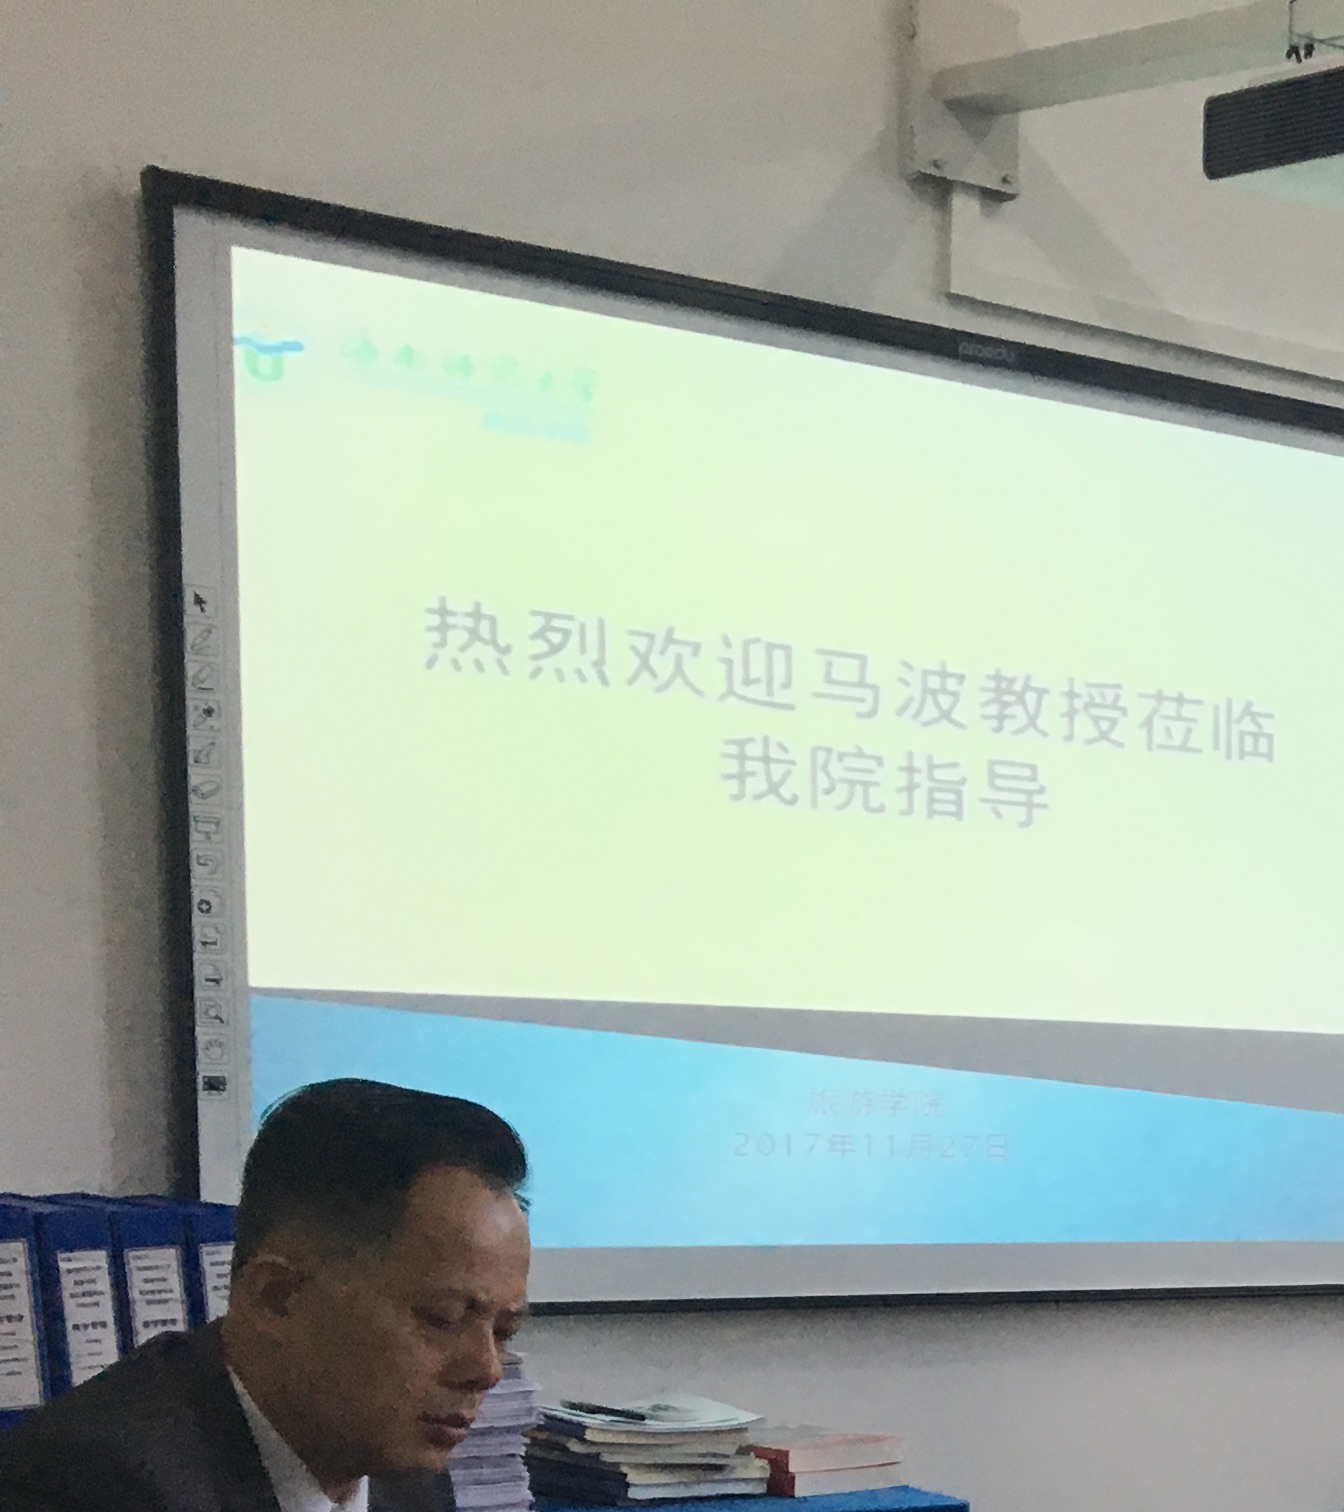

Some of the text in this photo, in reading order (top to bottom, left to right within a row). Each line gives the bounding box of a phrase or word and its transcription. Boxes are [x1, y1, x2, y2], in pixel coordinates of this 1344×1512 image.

[423, 595, 1277, 764] 热烈欢迎马波教授莅临
[720, 734, 1049, 829] 我院指导
[732, 1131, 1011, 1161] 2017年11月27日
